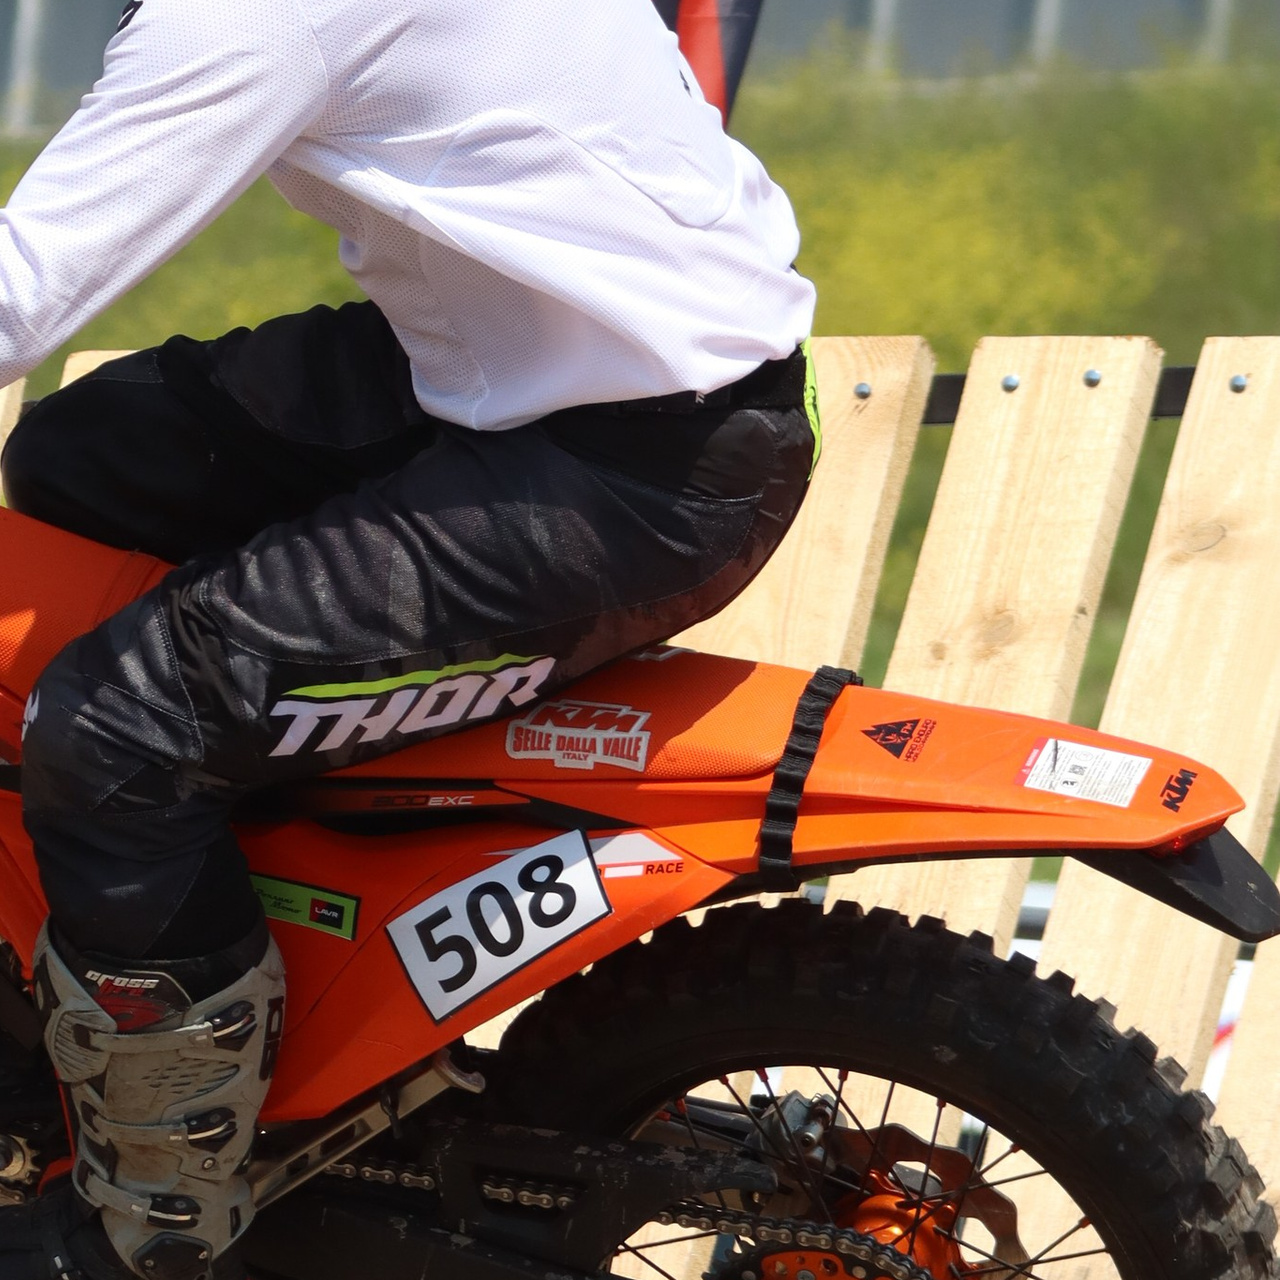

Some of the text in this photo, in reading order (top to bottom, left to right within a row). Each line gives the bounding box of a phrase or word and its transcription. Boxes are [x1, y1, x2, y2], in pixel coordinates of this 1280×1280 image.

[269, 656, 556, 757] THOR
[529, 703, 643, 733] KTM
[513, 726, 642, 762] SELLE DALLA VALLE
[562, 752, 589, 761] ITALY
[1160, 768, 1198, 813] KTM
[645, 862, 684, 875] RACE
[315, 907, 338, 918] LAVR
[414, 854, 577, 993] 508
